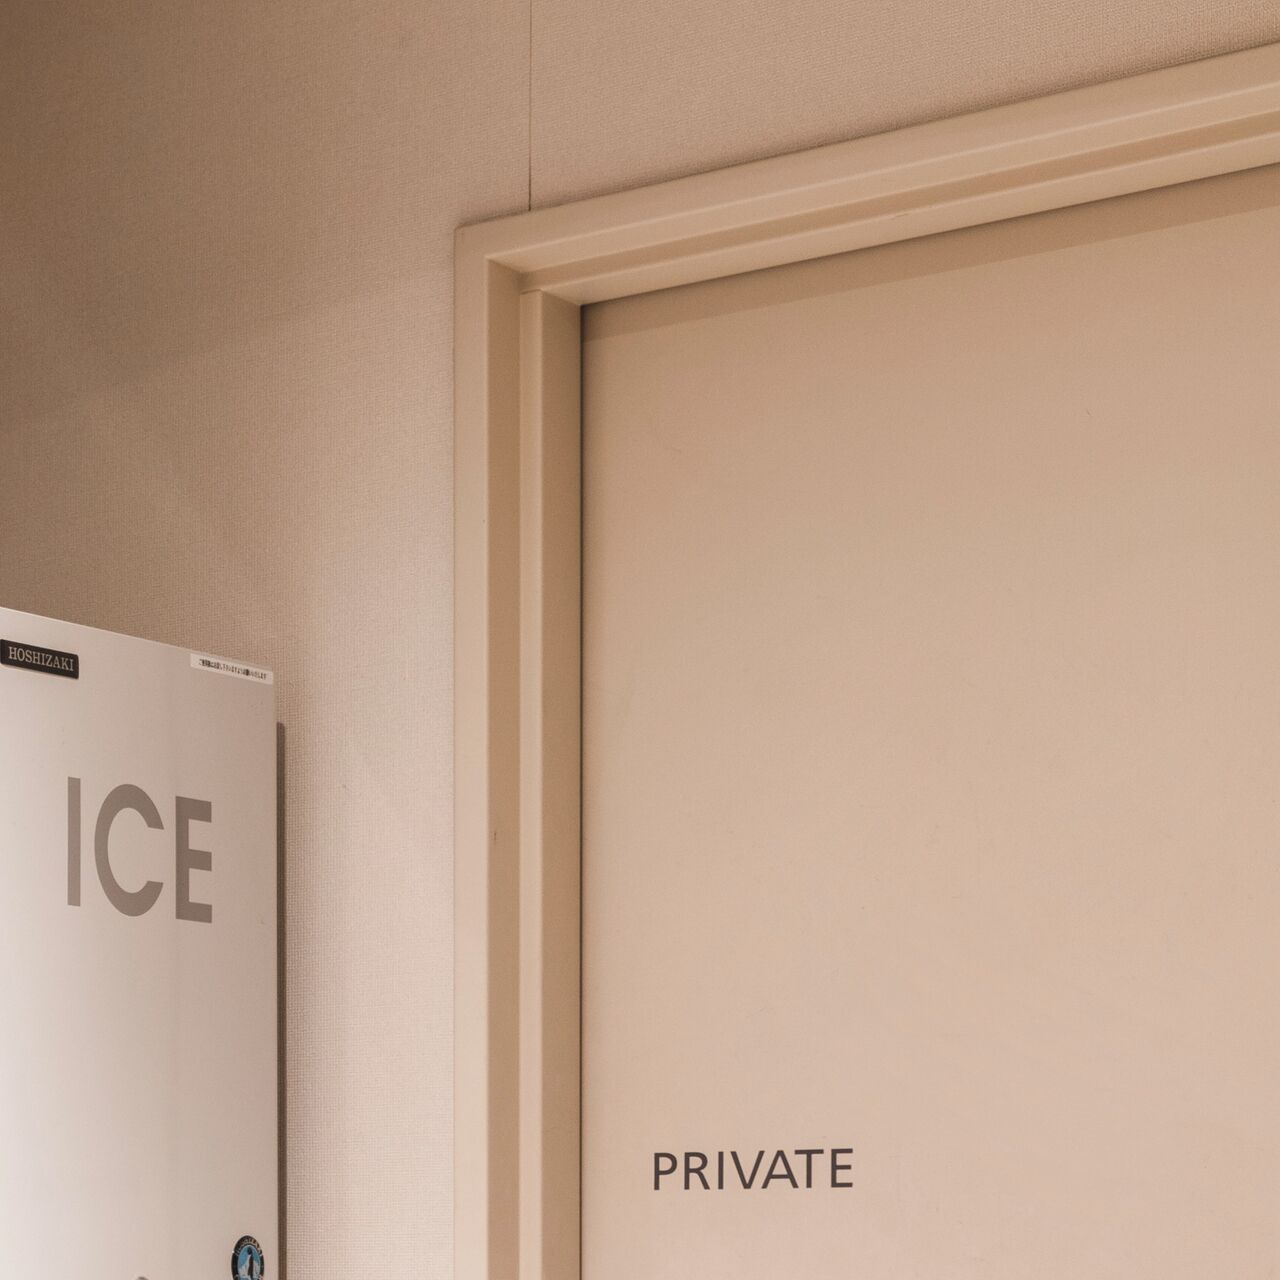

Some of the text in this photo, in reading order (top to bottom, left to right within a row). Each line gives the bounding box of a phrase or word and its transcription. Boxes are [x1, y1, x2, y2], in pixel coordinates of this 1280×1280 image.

[8, 646, 74, 672] HOSHIZAKI
[68, 776, 213, 924] ICE
[654, 1148, 853, 1190] PRIVATE
